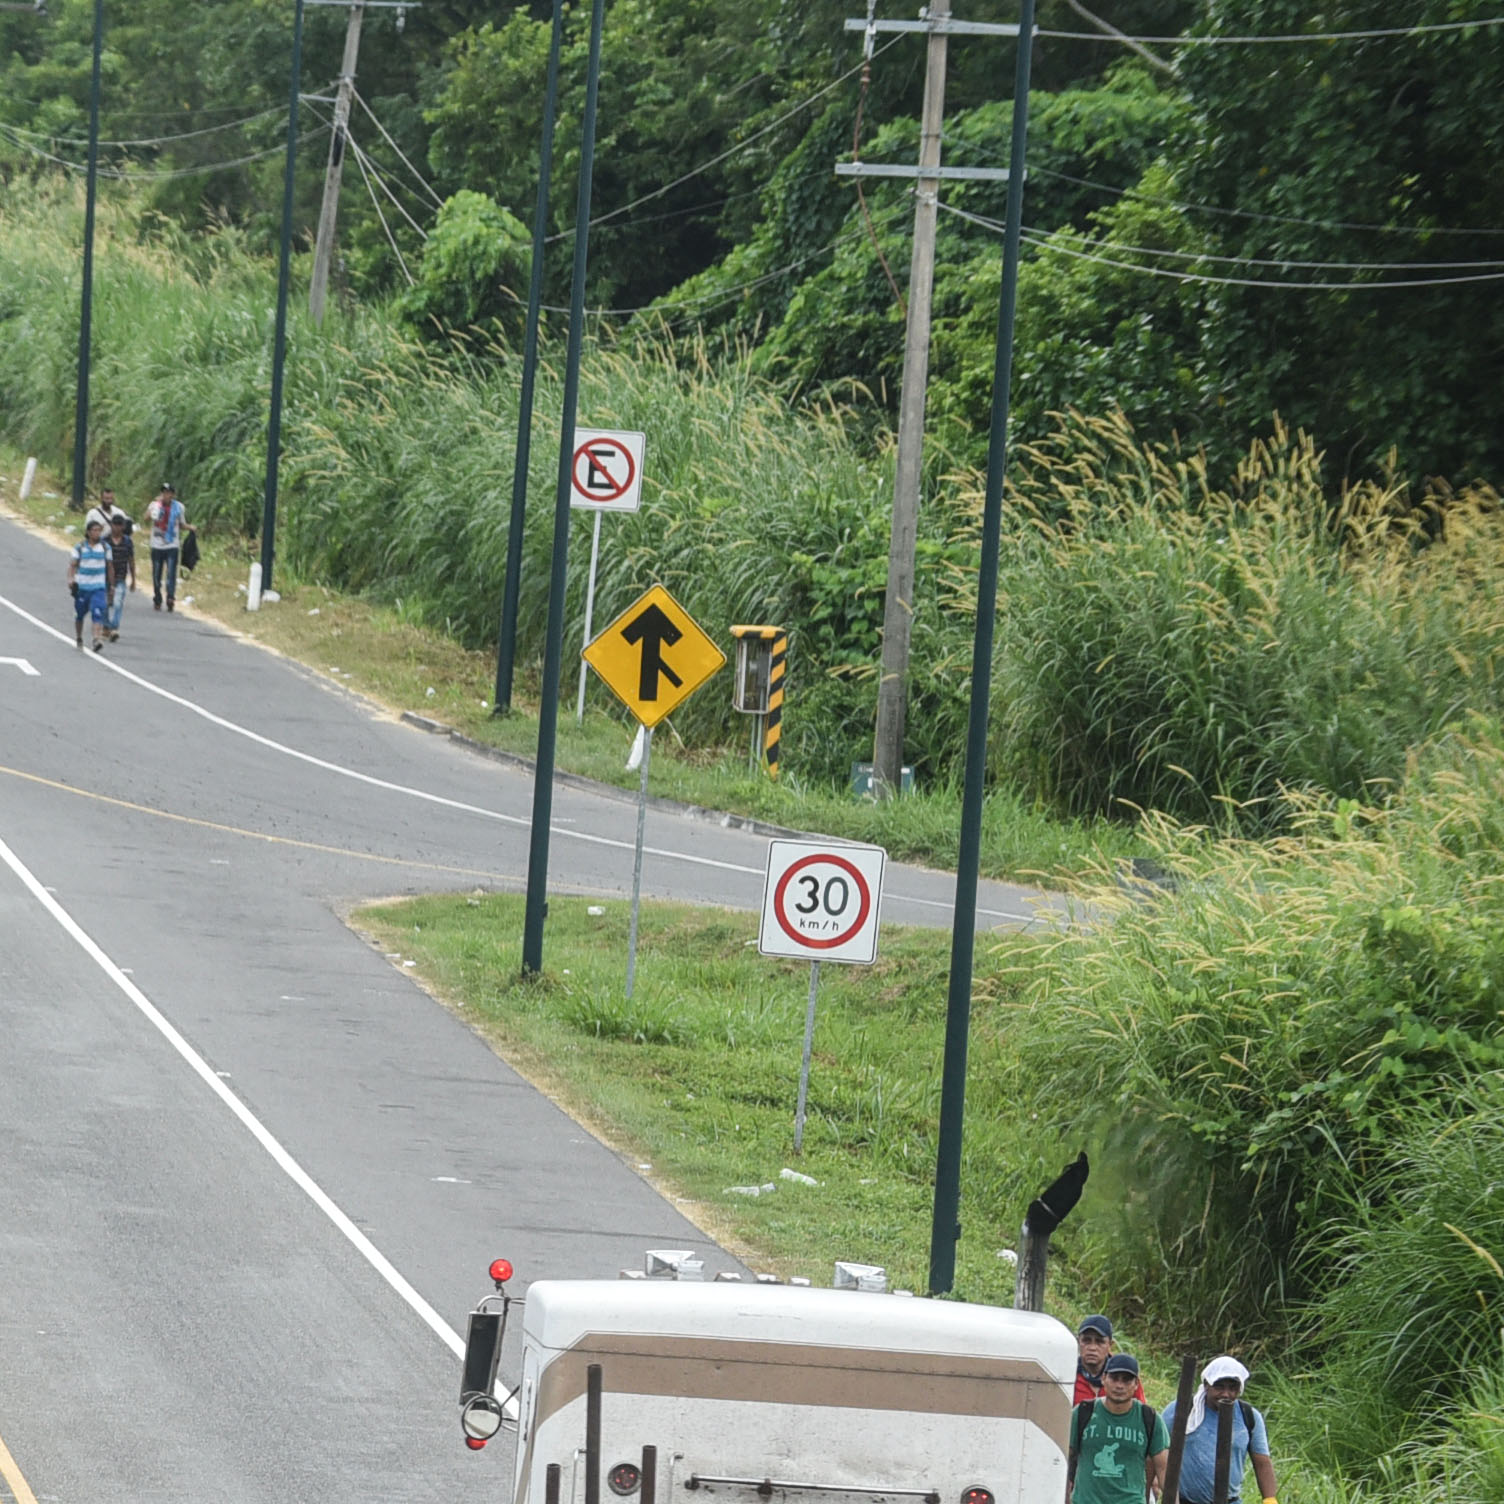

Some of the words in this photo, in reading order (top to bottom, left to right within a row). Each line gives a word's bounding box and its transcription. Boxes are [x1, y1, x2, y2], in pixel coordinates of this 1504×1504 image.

[587, 449, 616, 490] E
[795, 875, 849, 917] 30
[799, 918, 840, 931] km/h
[1107, 1425, 1145, 1445] LOUIS
